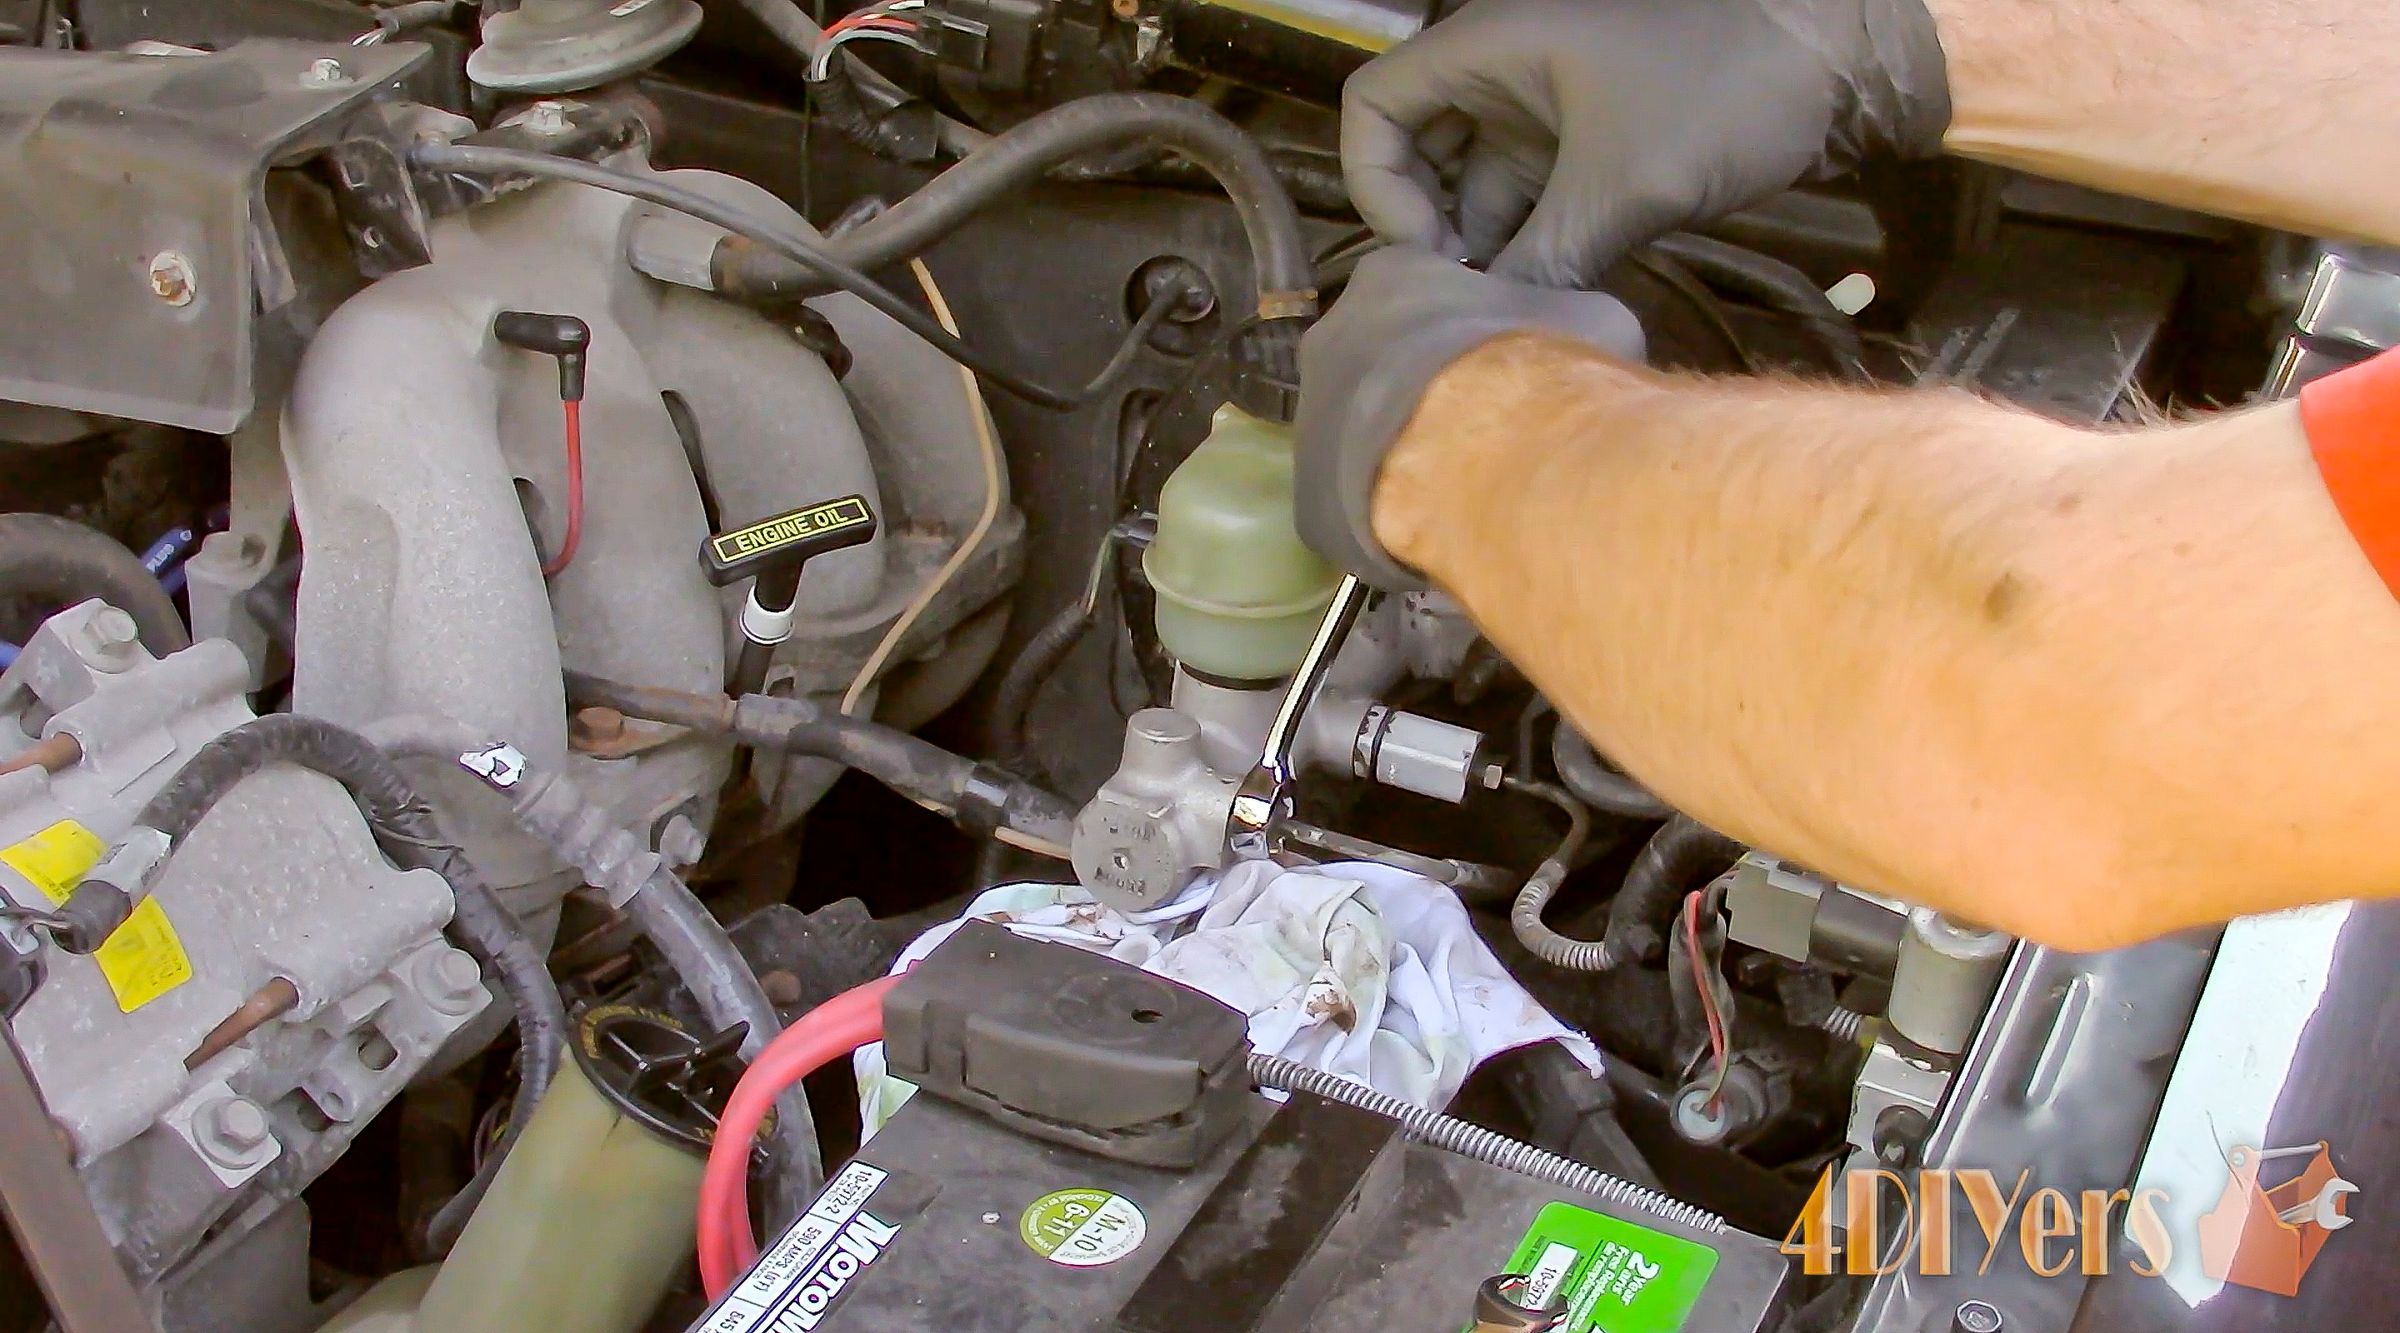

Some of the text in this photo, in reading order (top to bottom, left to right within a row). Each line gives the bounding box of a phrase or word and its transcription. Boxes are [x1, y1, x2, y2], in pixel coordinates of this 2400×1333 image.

[735, 508, 849, 552] ENGINE OIL
[1043, 1201, 1092, 1237] 6-11
[1074, 1213, 1126, 1251] M-10
[1621, 1251, 1660, 1306] 2 Year
